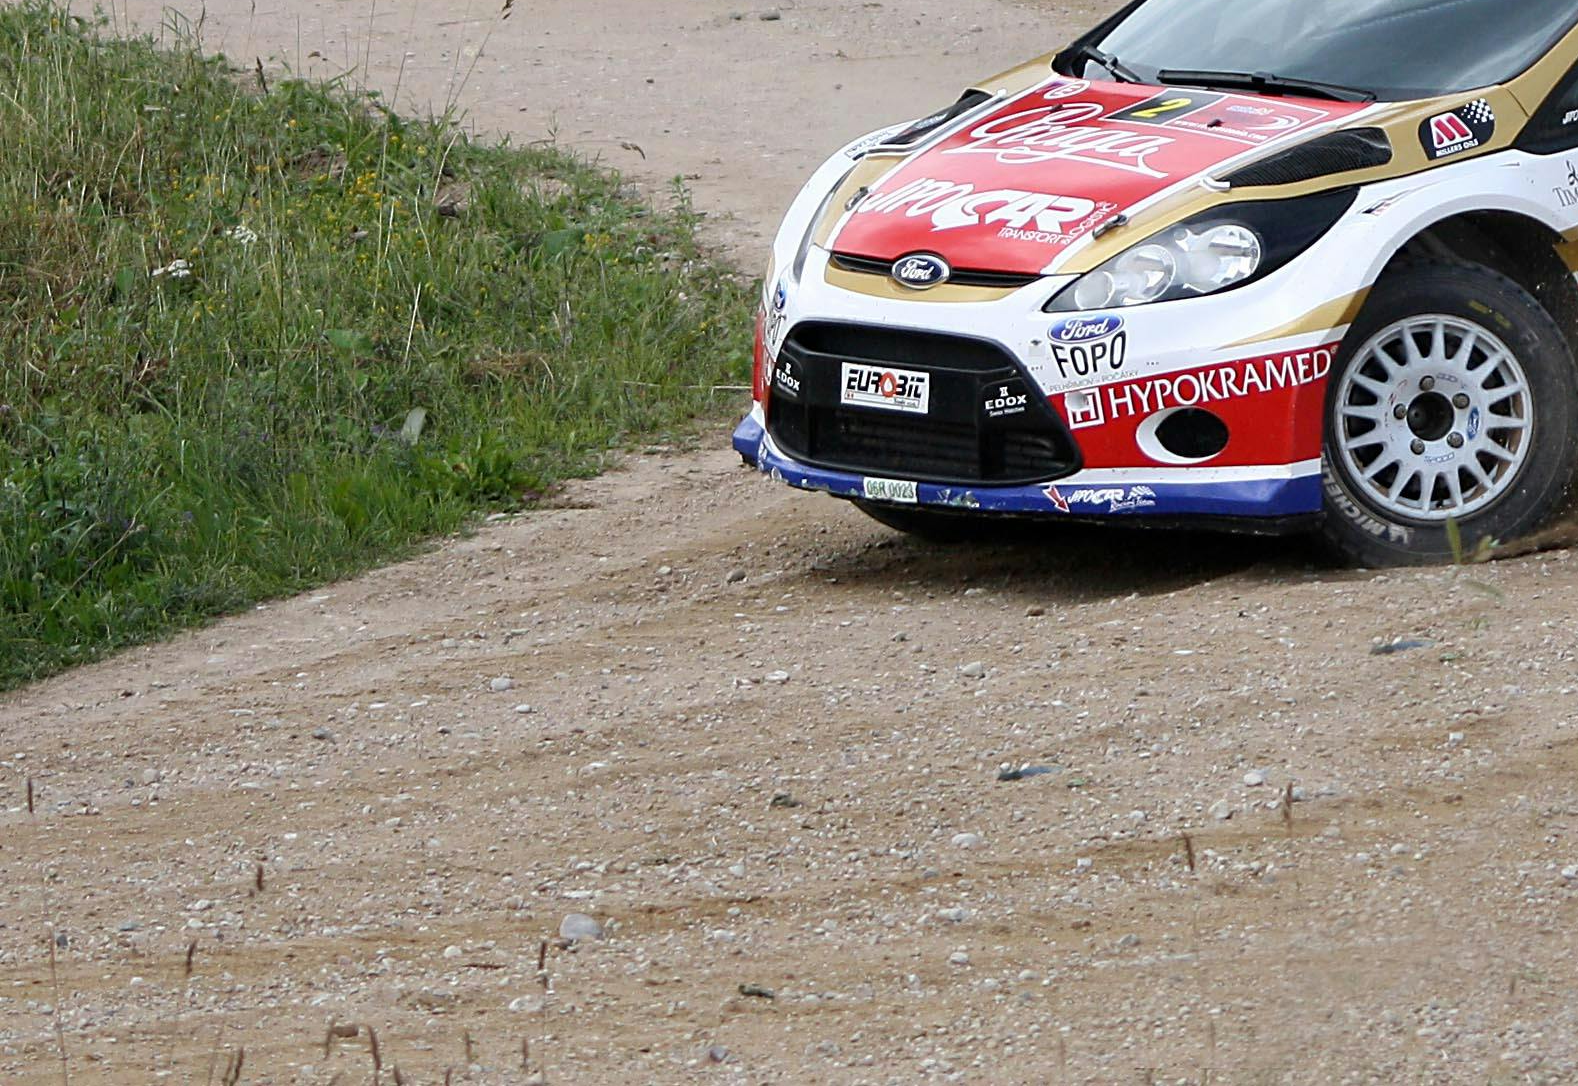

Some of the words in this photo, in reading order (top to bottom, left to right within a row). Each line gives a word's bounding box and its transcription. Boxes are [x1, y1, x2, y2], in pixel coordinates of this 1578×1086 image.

[1130, 98, 1192, 118] 2
[942, 103, 1176, 179] Praga
[997, 226, 1062, 244] TRANSPORT
[901, 258, 935, 280] Ford
[1061, 315, 1110, 340] Ford
[1050, 330, 1127, 379] FOPO
[776, 368, 800, 391] EDOX
[1108, 349, 1332, 419] HYPOKRAMED
[985, 394, 1027, 410] EDOX
